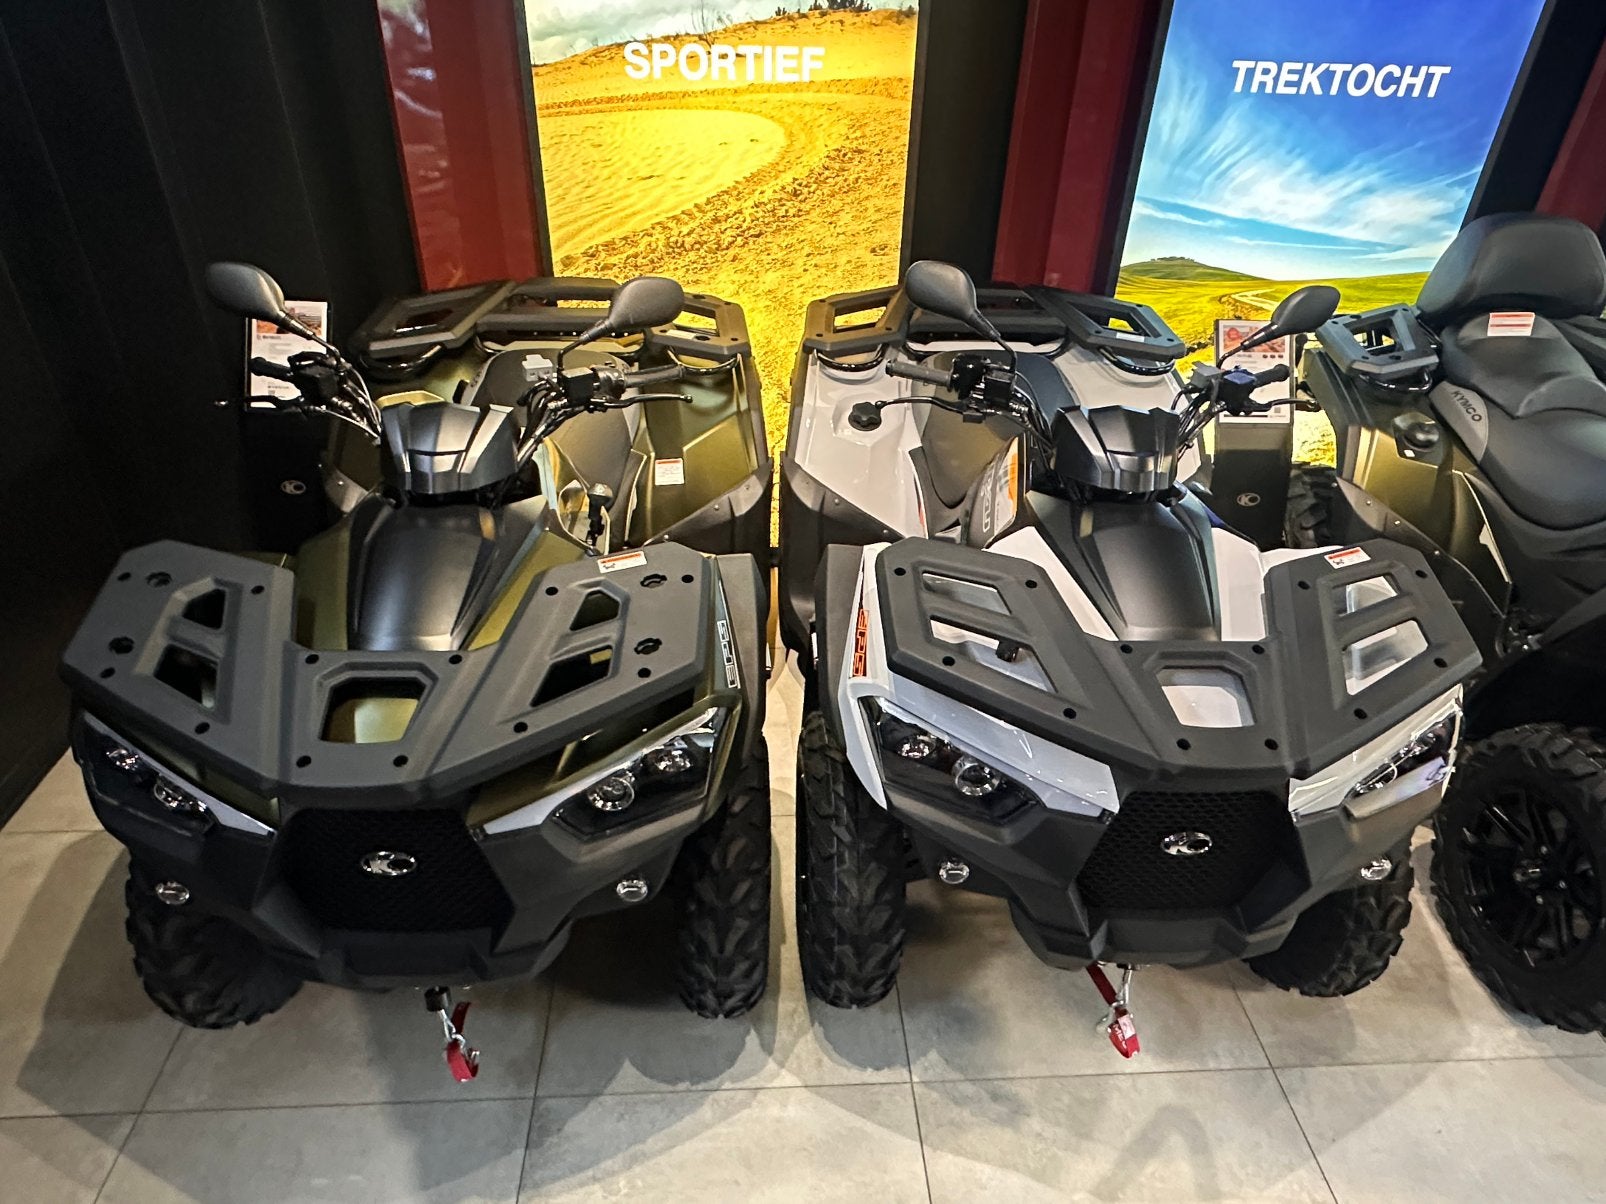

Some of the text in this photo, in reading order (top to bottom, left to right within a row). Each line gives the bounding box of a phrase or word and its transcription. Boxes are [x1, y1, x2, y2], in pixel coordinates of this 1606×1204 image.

[624, 41, 825, 82] SPORTIEF
[1232, 60, 1451, 98] TREKTOCHT
[1451, 390, 1482, 421] KYMCO
